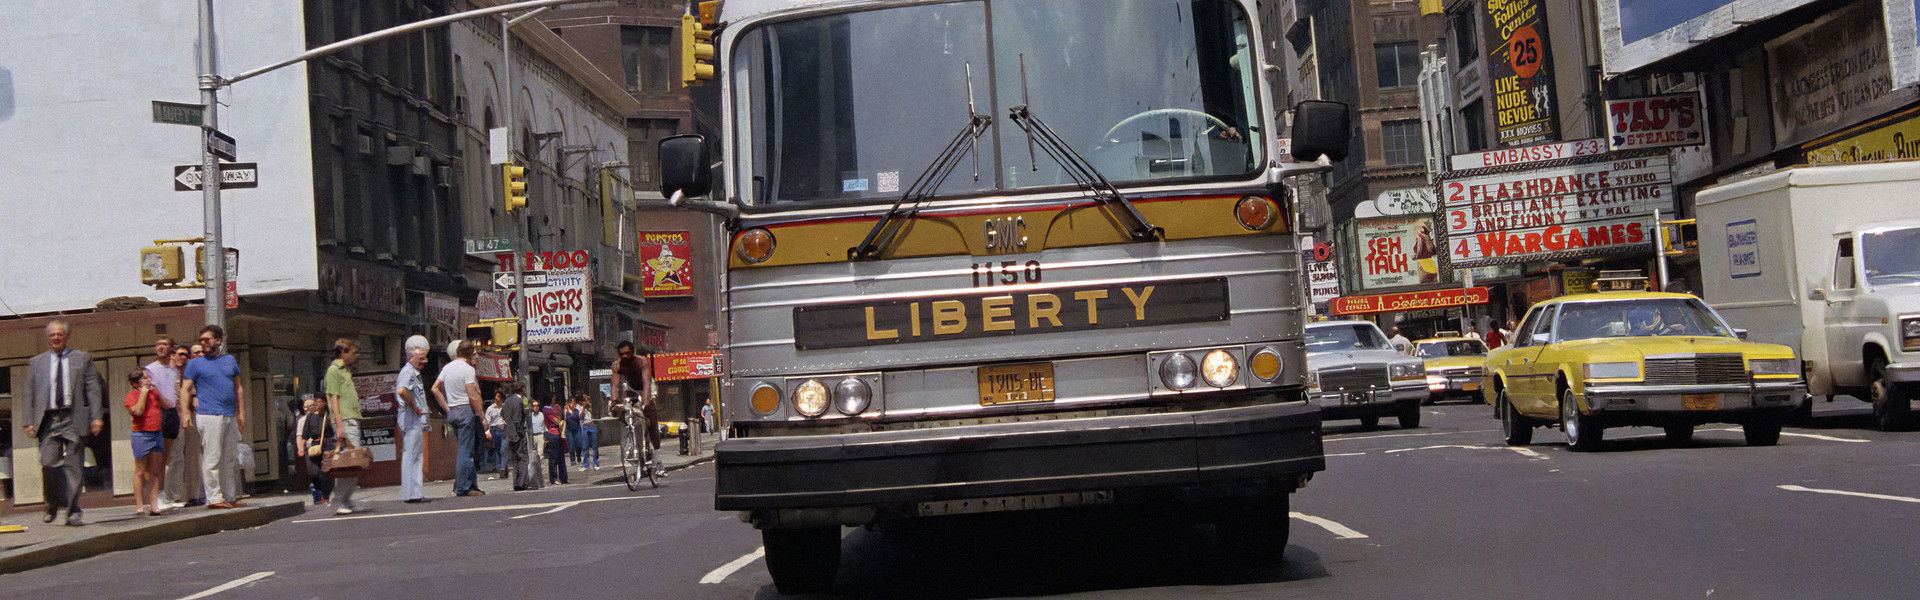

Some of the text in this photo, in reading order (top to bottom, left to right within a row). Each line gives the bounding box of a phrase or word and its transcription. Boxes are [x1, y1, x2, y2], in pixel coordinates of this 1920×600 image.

[1501, 4, 1537, 40] Center
[1514, 38, 1537, 67] 25
[1495, 75, 1520, 94] LIVE
[1497, 89, 1528, 111] NUDE
[1498, 104, 1535, 126] REVUE
[1610, 97, 1694, 133] TAD'S
[1627, 131, 1684, 146] STEAKS
[1483, 140, 1599, 167] EMBASSY 2-3
[1614, 159, 1648, 171] DOLBY
[1448, 171, 1657, 202] 2 FLASHDANCE STEREO
[1472, 185, 1661, 219] BRILLIANT EXCITING
[985, 216, 1028, 249] GMC
[1450, 211, 1467, 230] 3
[1474, 215, 1507, 233] AND
[1511, 211, 1567, 230] FUNNY
[1608, 205, 1630, 217] MAG
[541, 249, 589, 270] ZOO
[1454, 239, 1470, 259] 4
[972, 259, 1042, 288] 1150
[1366, 253, 1408, 275] TALK
[507, 288, 583, 319] SINGERS
[865, 286, 1155, 340] LIBERTY
[540, 314, 573, 327] CLUB
